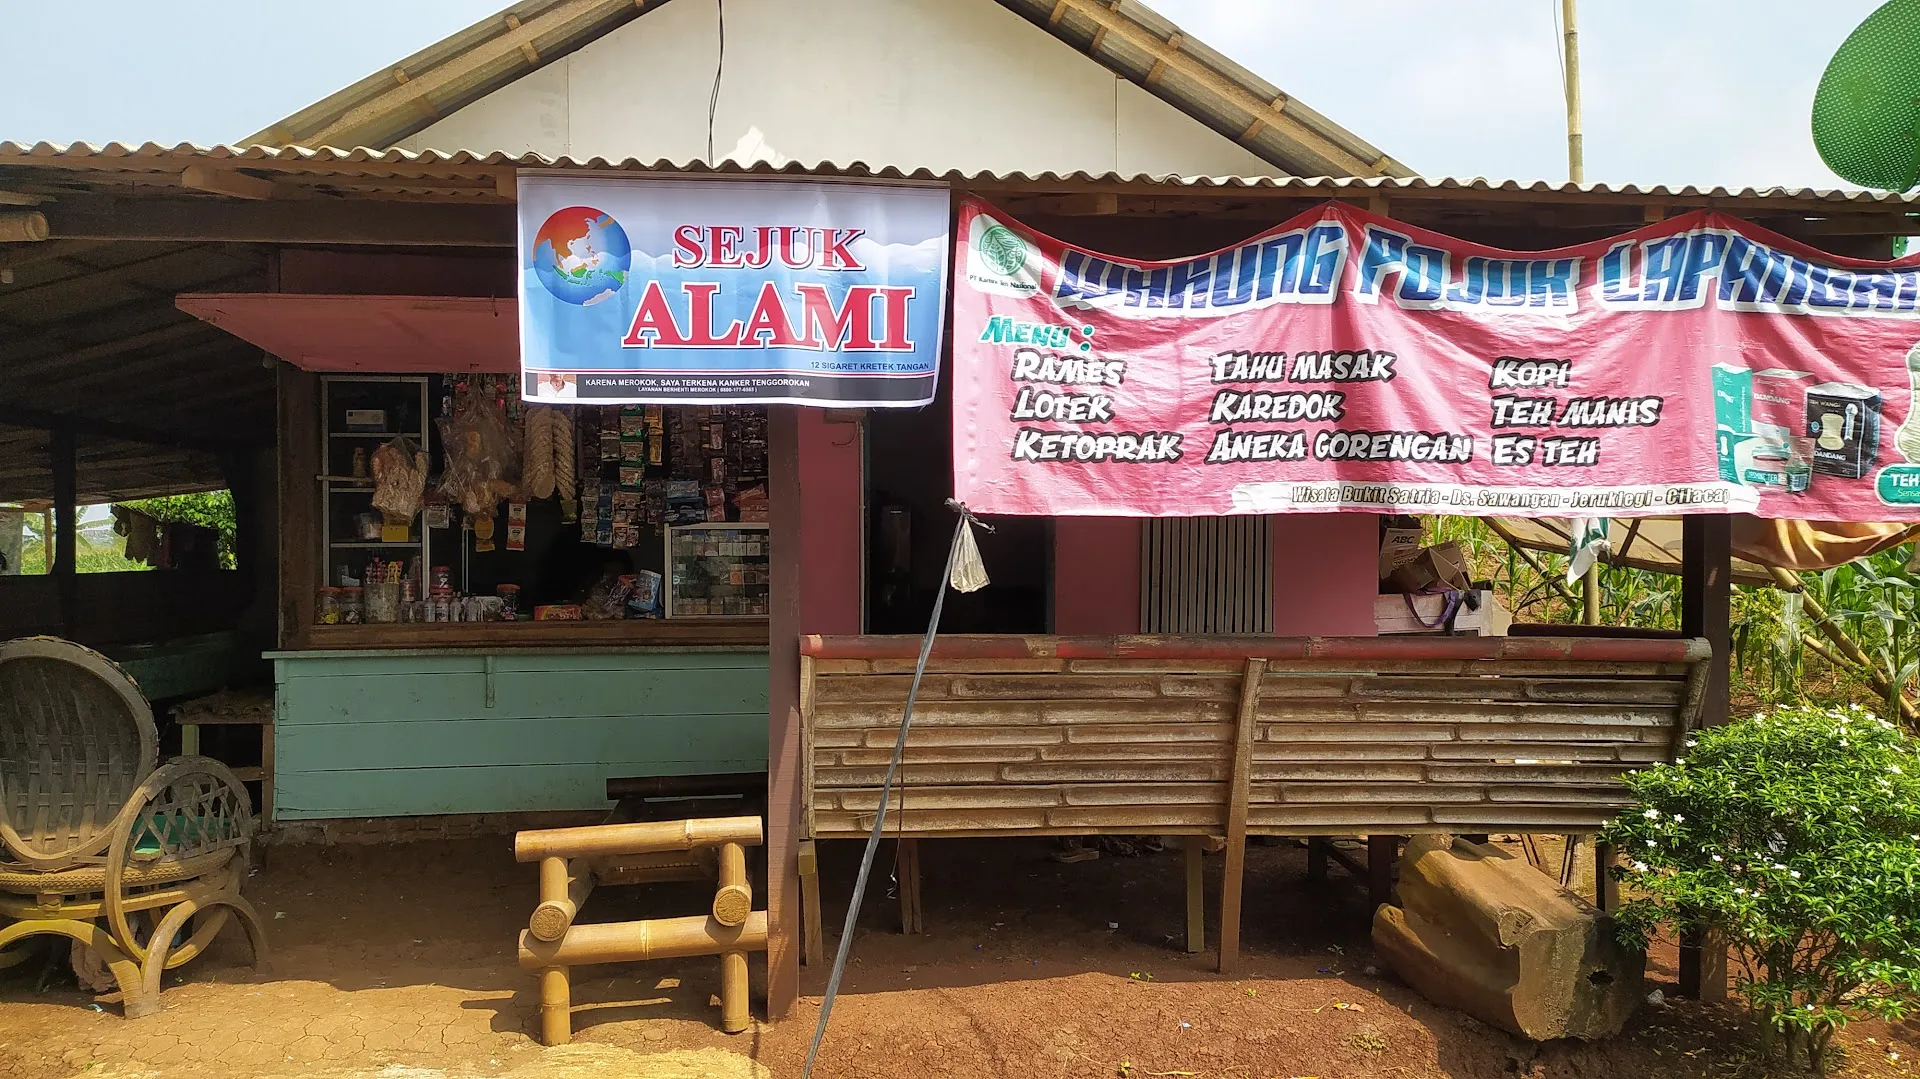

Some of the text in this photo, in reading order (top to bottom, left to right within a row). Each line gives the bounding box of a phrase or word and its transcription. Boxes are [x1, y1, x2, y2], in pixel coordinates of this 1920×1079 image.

[672, 224, 866, 271] SEJUK
[620, 280, 916, 352] ALAMI
[618, 379, 659, 387] MEROKOK,
[681, 379, 718, 387] TERKENA
[719, 379, 750, 387] KANKER
[751, 378, 810, 387] TENGGOROKAN
[810, 361, 929, 371] 12 SIGARET KRETEK TANGAN
[1012, 349, 1126, 384] RAMES
[1211, 349, 1397, 384] TAHU MASAK
[1490, 357, 1572, 388] KOPI
[1011, 387, 1115, 423] LOTEK
[1209, 390, 1345, 424] KAREDOK
[1491, 394, 1663, 428] TEH MANIS
[1011, 427, 1184, 463] KETOPRAK
[1205, 428, 1474, 464] ANEKA GORENGAN
[1492, 433, 1600, 466] ES TEH
[1890, 473, 1919, 486] TEH
[1291, 486, 1338, 503] Wisata
[1341, 486, 1388, 504] Bukit
[1388, 487, 1440, 505] Satria
[1451, 489, 1475, 506] Ds.
[1477, 490, 1560, 508] Sawangan
[1571, 489, 1652, 508] Jeruklegi
[1391, 535, 1415, 544] ABC
